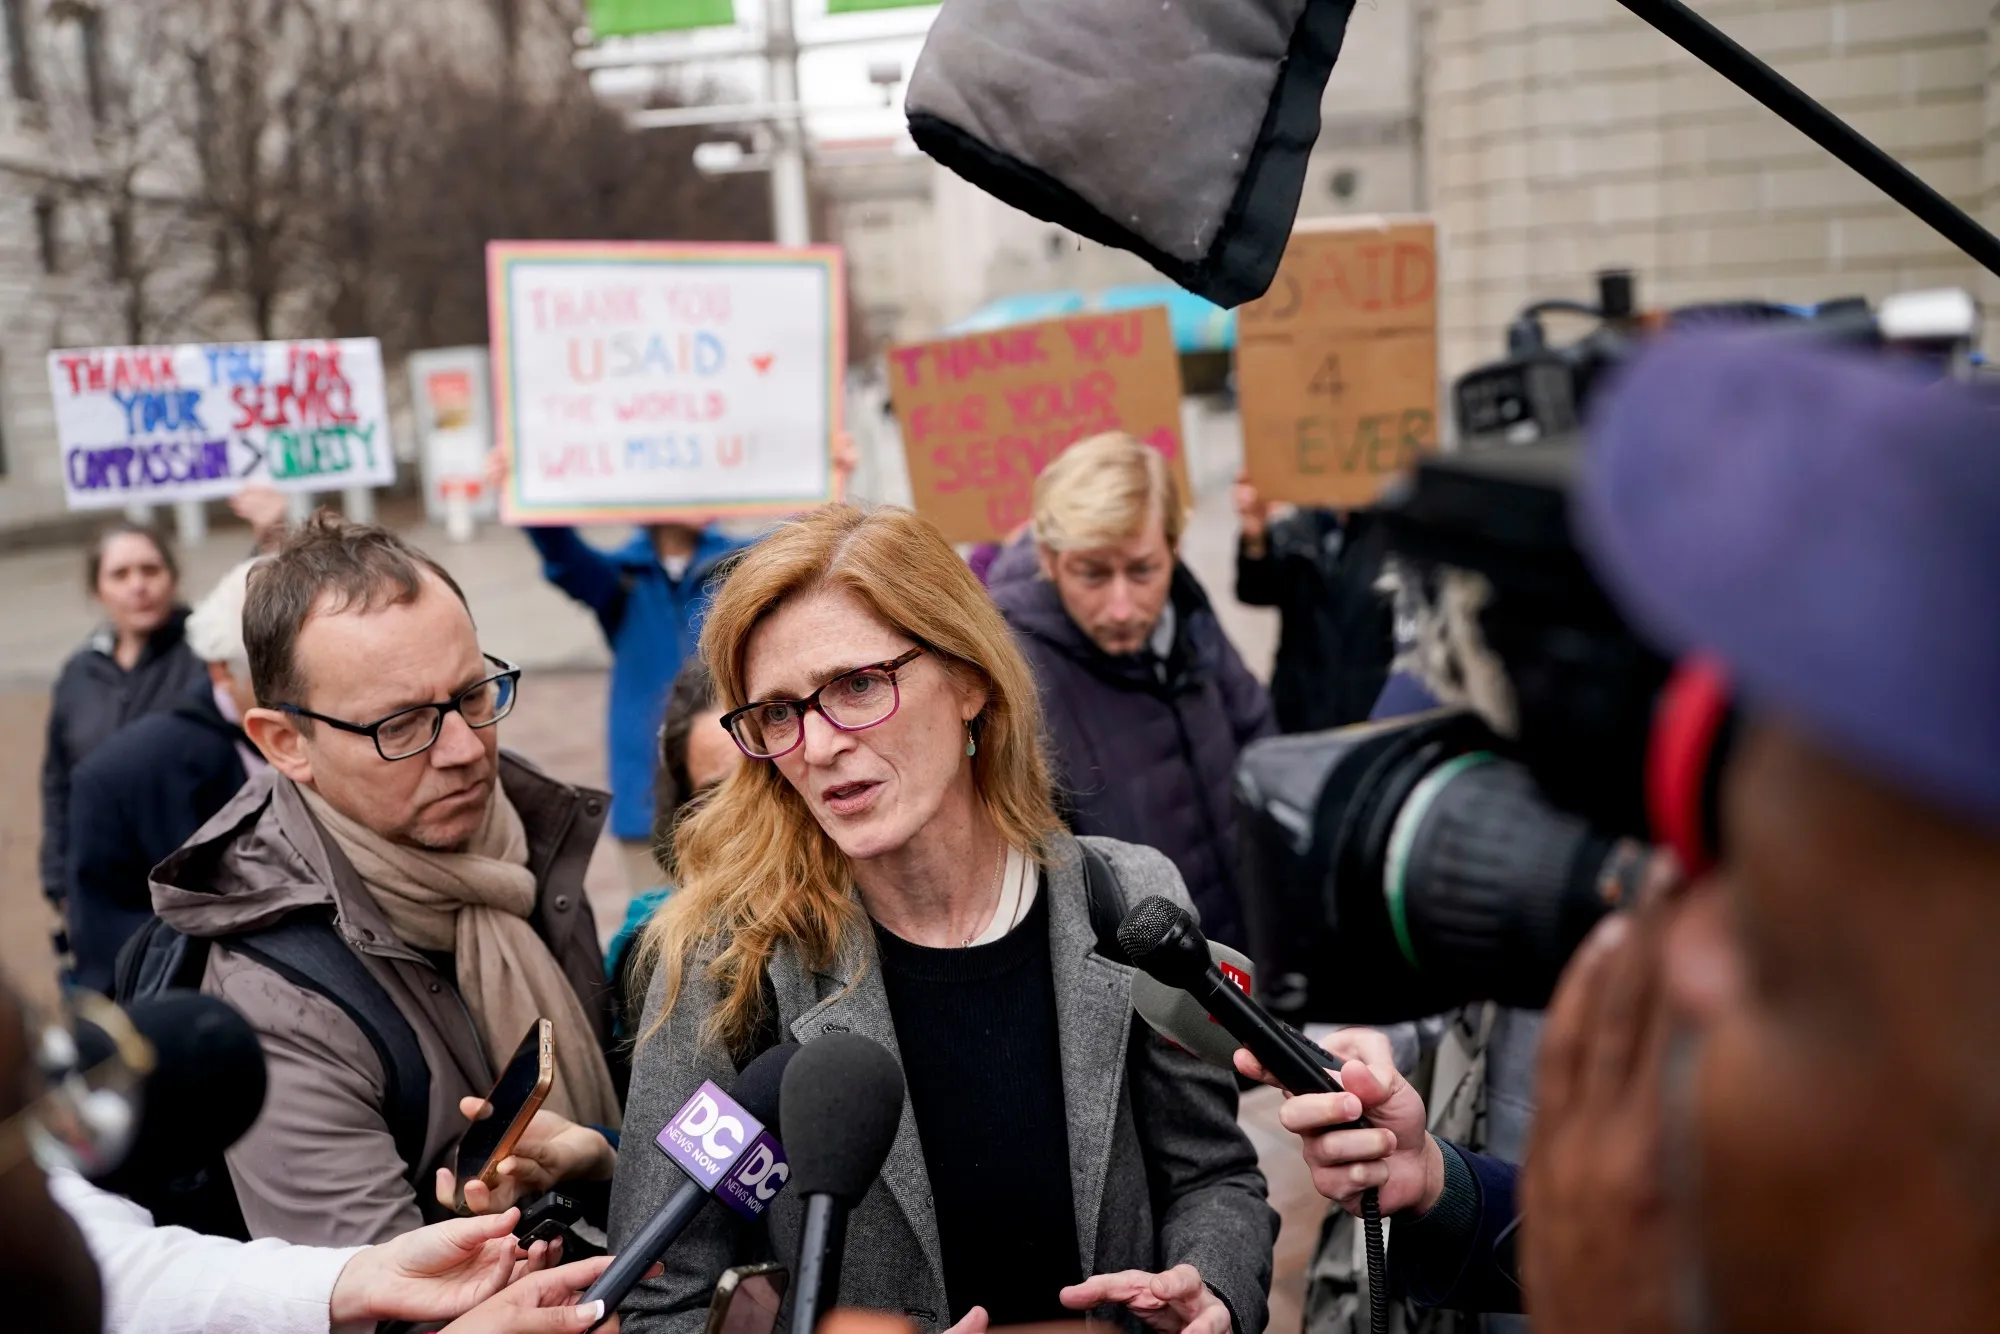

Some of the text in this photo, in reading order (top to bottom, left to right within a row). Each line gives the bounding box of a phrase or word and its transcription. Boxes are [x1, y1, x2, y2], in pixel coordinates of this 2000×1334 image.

[1246, 240, 1436, 320] SAID
[528, 282, 733, 332] THANK YOU
[57, 353, 181, 396] THANK
[566, 330, 726, 386] USAID
[889, 312, 1143, 388] THANK YOU
[1306, 351, 1347, 402] 4
[110, 386, 207, 436] YOUR
[612, 387, 728, 424] WORLD
[910, 369, 1119, 445] FOR YOUR
[537, 440, 615, 481] WILL
[622, 432, 704, 470] MISS
[1296, 408, 1433, 476] EVER
[665, 1125, 720, 1175] NEWS NOW
[675, 1091, 744, 1159] DC
[724, 1180, 764, 1214] NEWS NOW
[734, 1143, 789, 1200] DC
